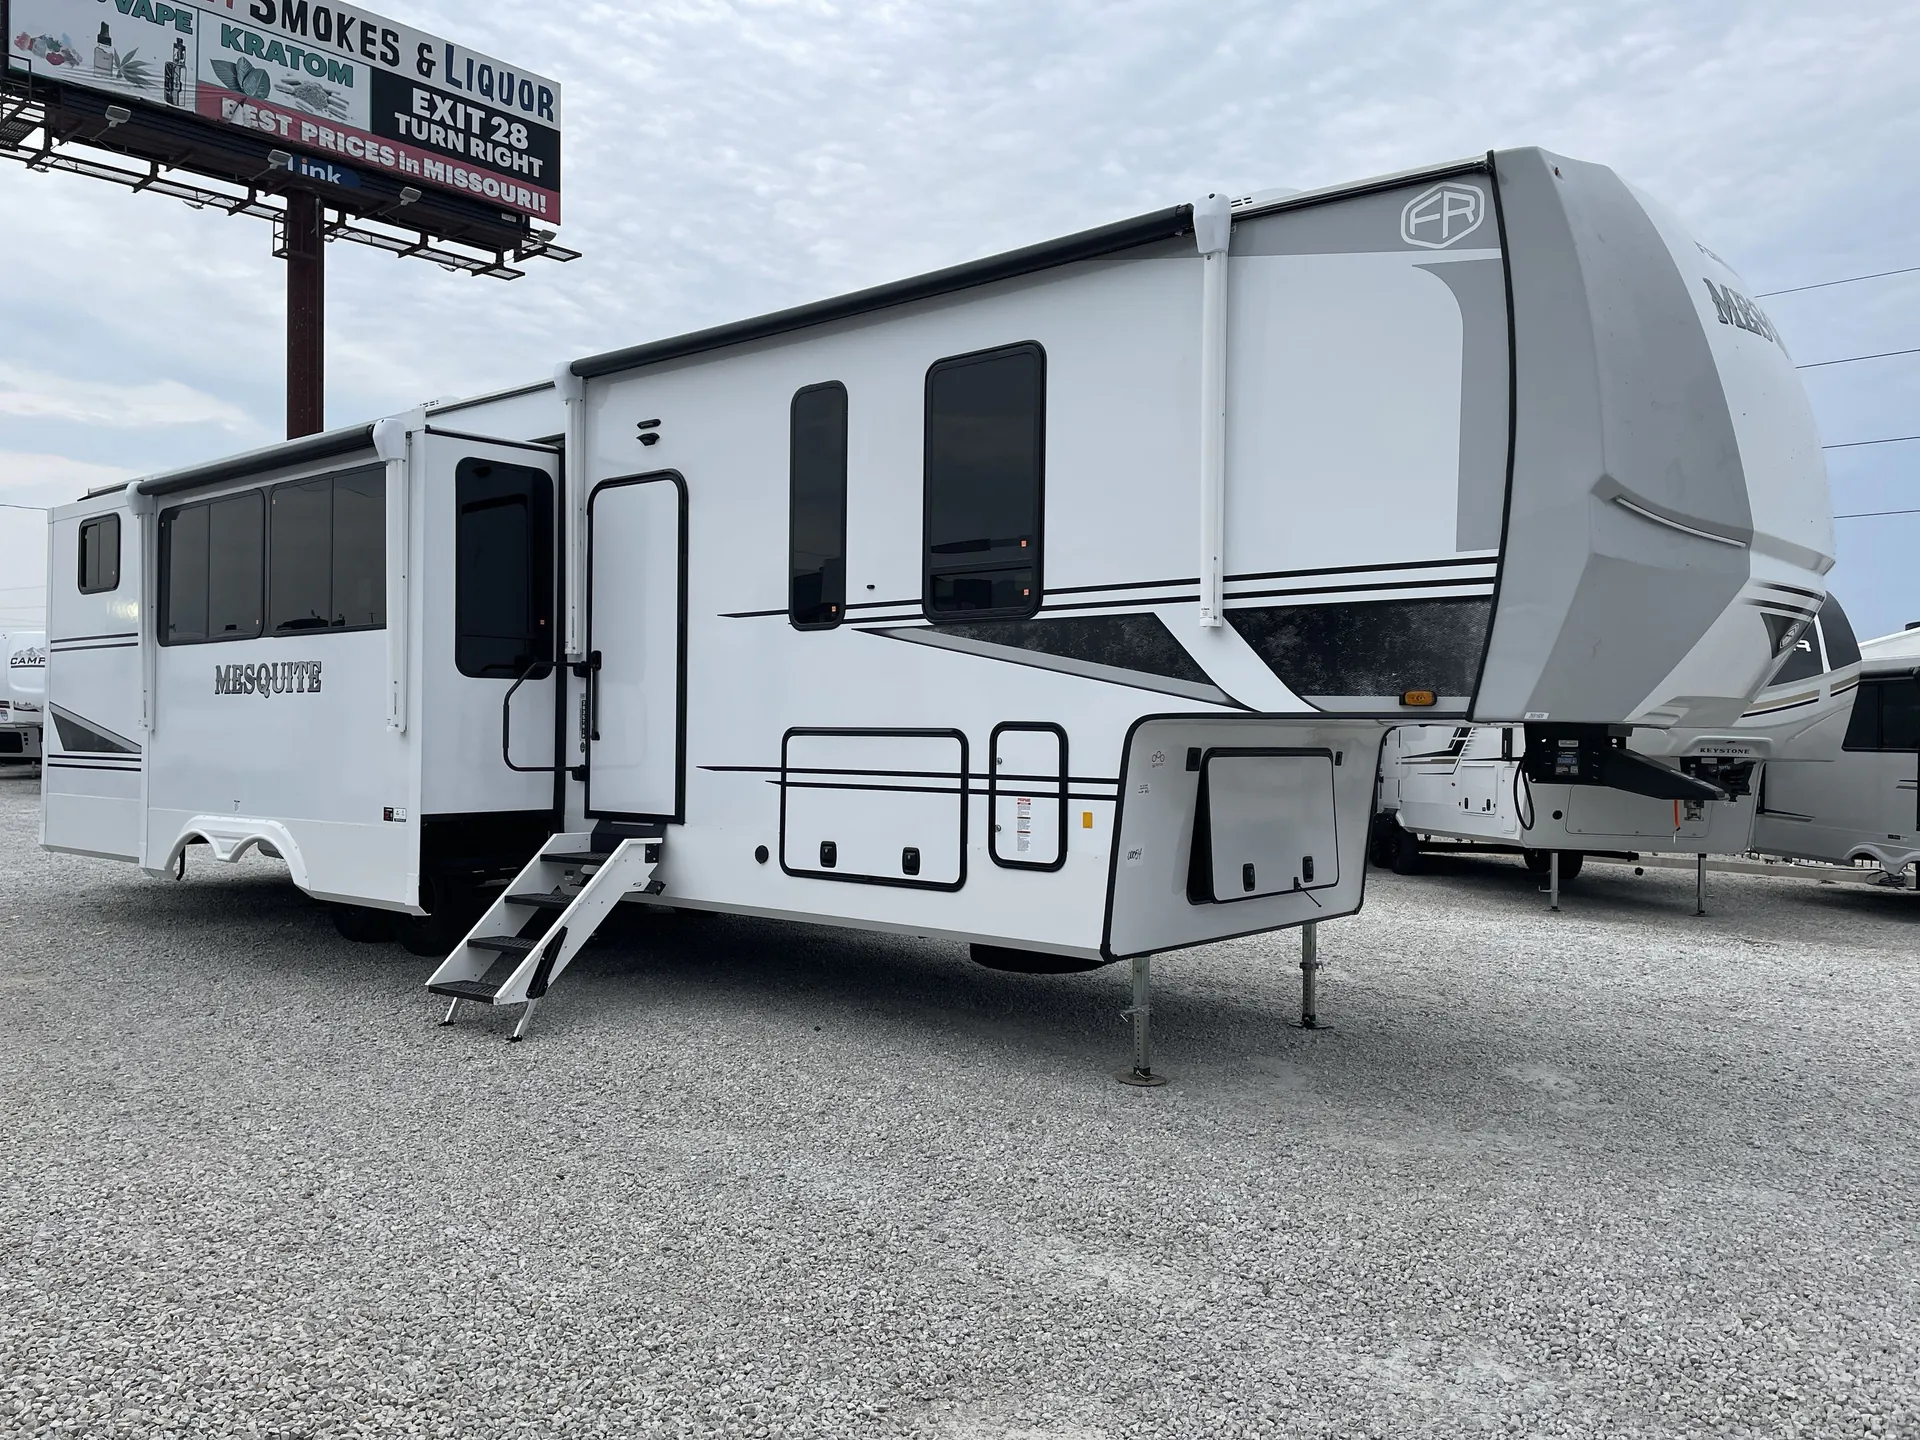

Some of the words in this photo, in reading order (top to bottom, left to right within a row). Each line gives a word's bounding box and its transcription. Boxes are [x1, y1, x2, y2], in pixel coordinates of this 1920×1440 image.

[114, 0, 193, 35] VAPE
[221, 22, 354, 88] KRATOM
[249, 0, 400, 68] SMOKES
[416, 42, 436, 79] &
[445, 43, 554, 123] LIQUOR
[222, 97, 292, 137] BEST
[301, 121, 396, 167] PRICES
[399, 150, 420, 175] in
[394, 111, 465, 153] TURN
[469, 137, 544, 178] RIGHT
[412, 87, 486, 135] EXIT
[490, 116, 529, 150] 28
[214, 660, 322, 699] MESQUITE
[1699, 747, 1751, 755] KEYSTONE
